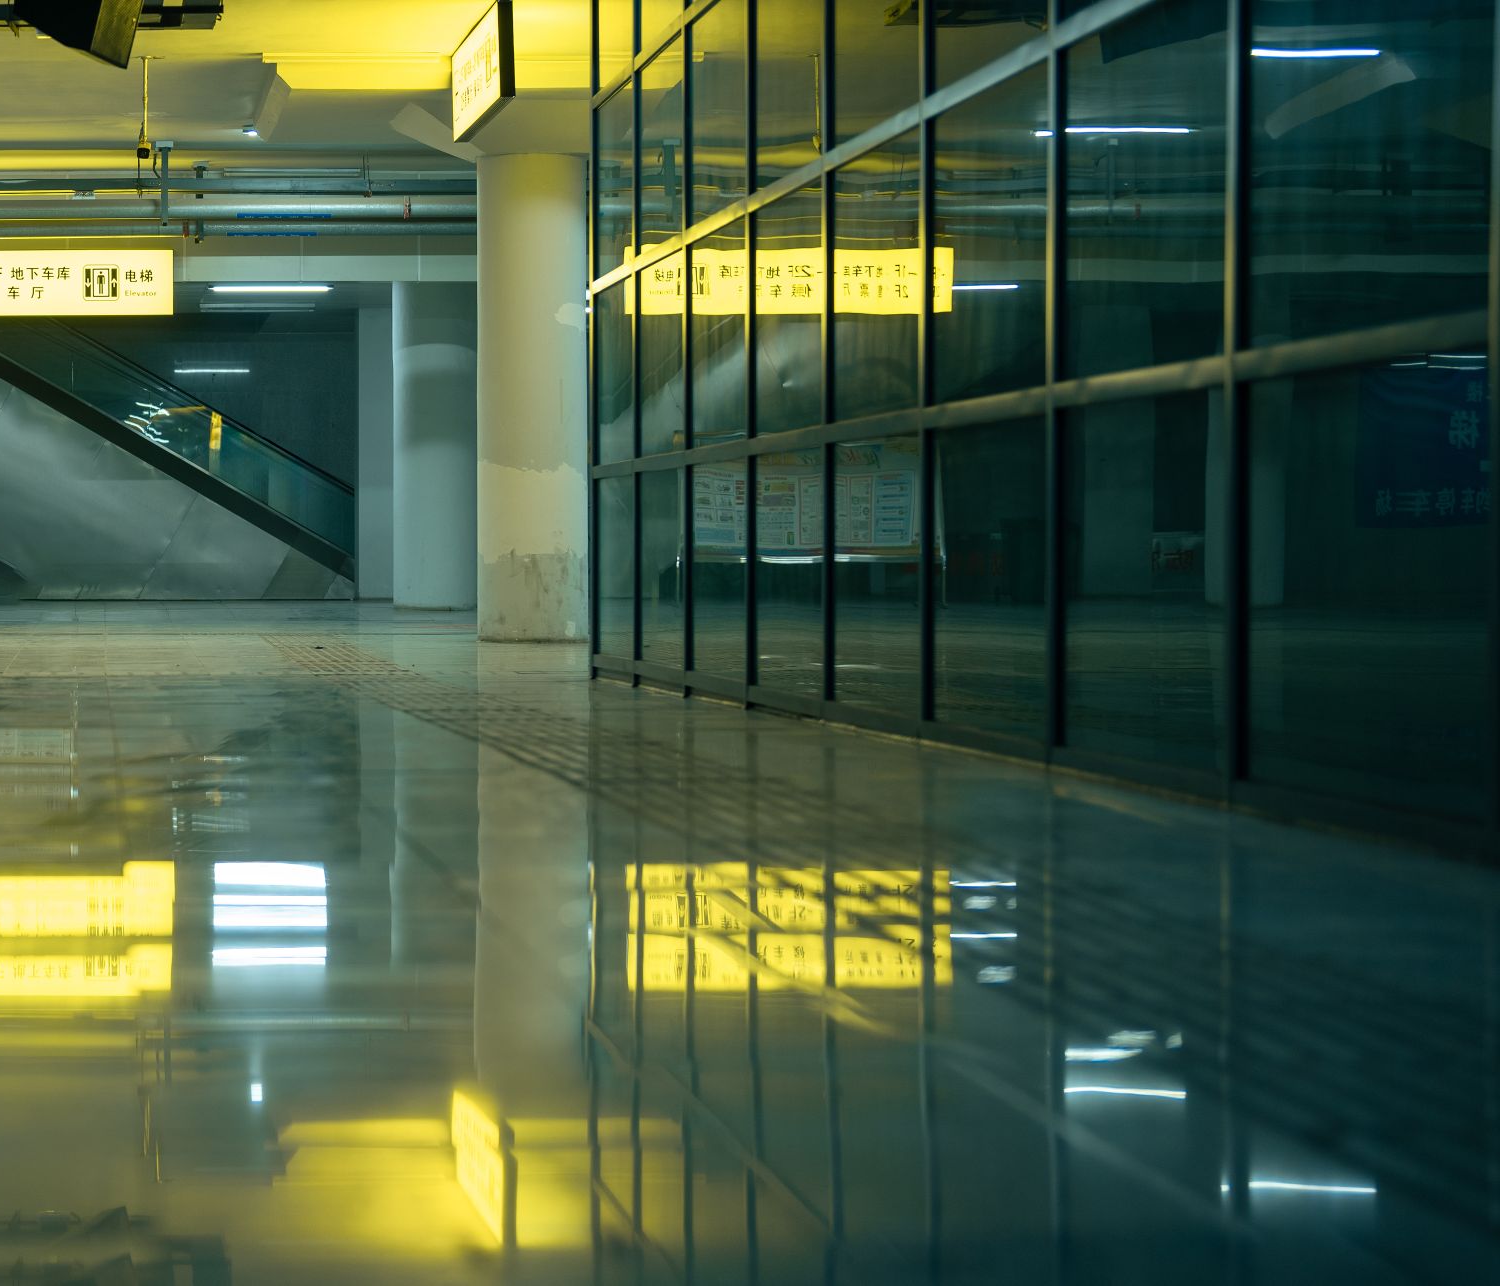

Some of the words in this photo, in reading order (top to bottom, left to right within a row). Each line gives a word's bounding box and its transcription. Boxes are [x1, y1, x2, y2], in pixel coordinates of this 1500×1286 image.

[10, 267, 71, 281] 地下车库
[125, 269, 154, 283] 电梯
